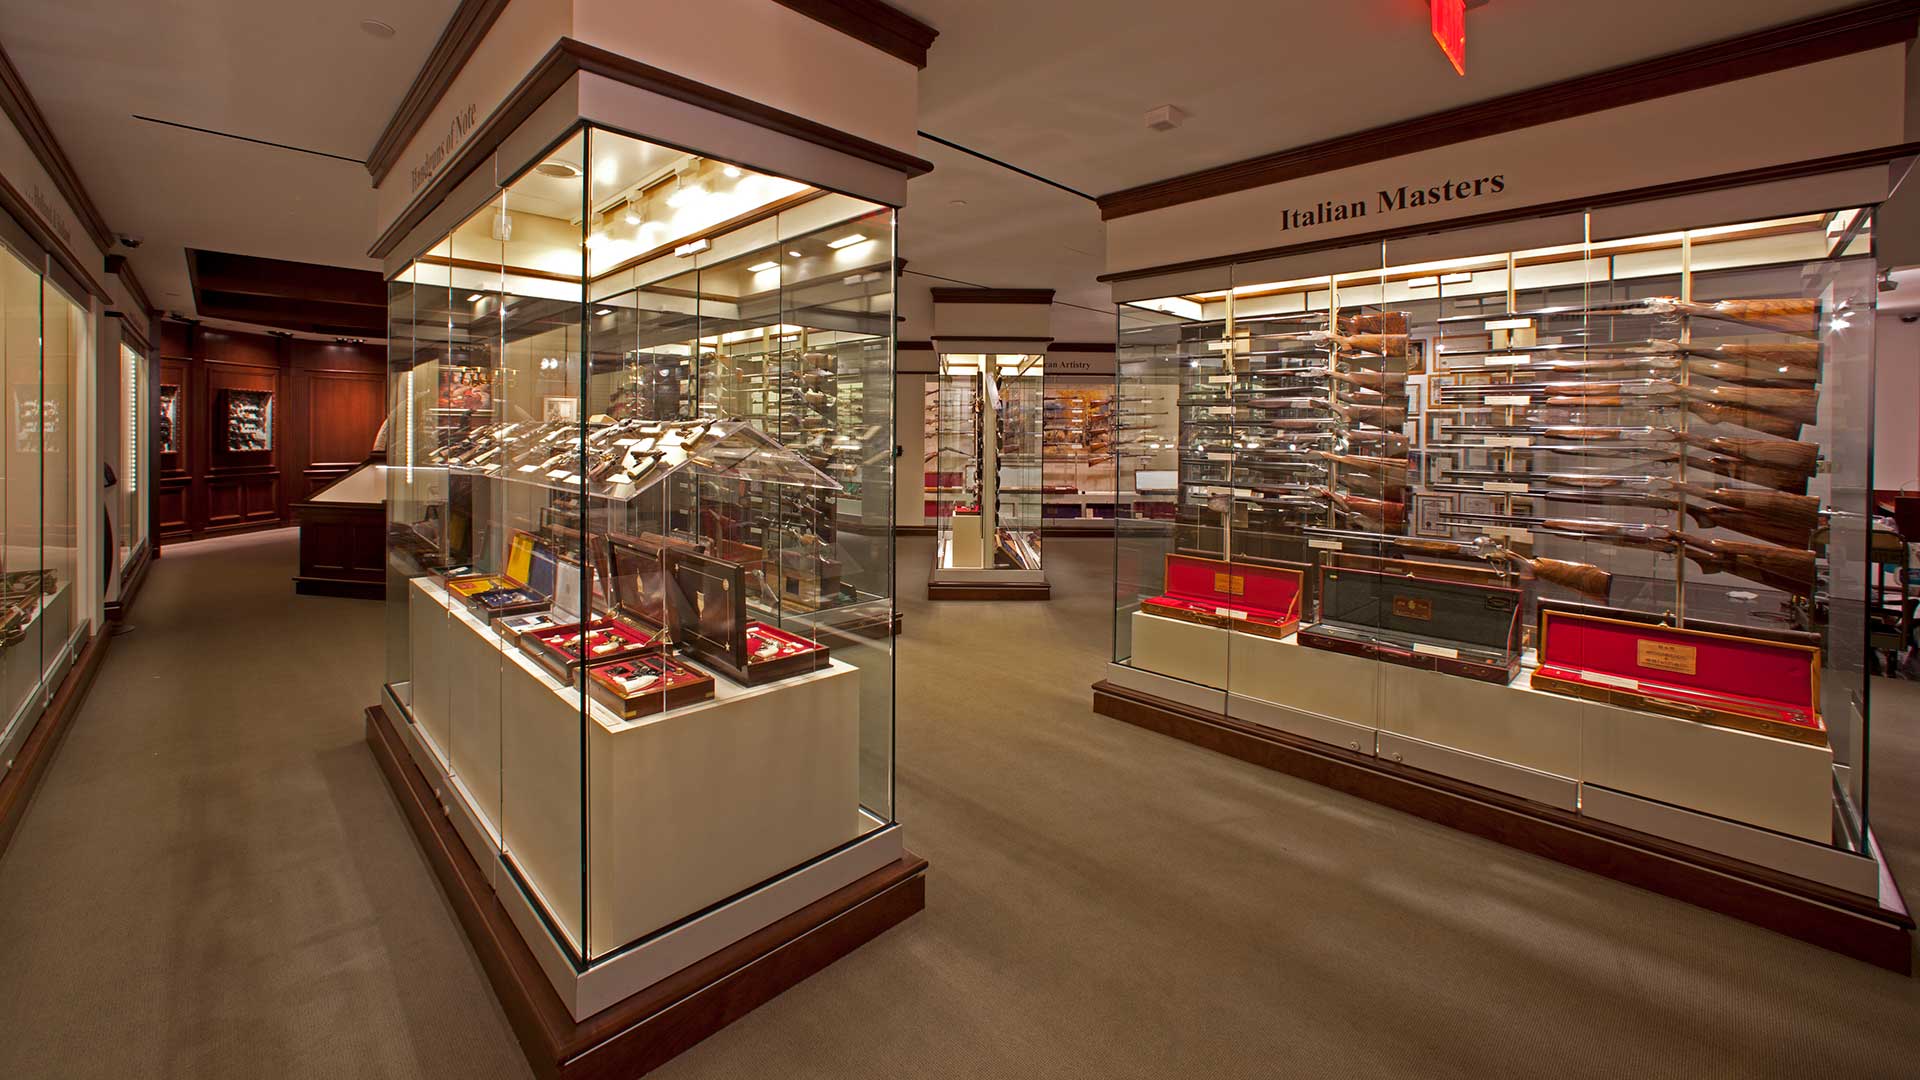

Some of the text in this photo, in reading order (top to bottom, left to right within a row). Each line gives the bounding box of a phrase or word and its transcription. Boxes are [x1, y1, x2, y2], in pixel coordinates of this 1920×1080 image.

[446, 119, 456, 155] of
[455, 103, 477, 143] Note
[1280, 174, 1505, 232] Italian Masters
[1060, 360, 1090, 370] Artistry
